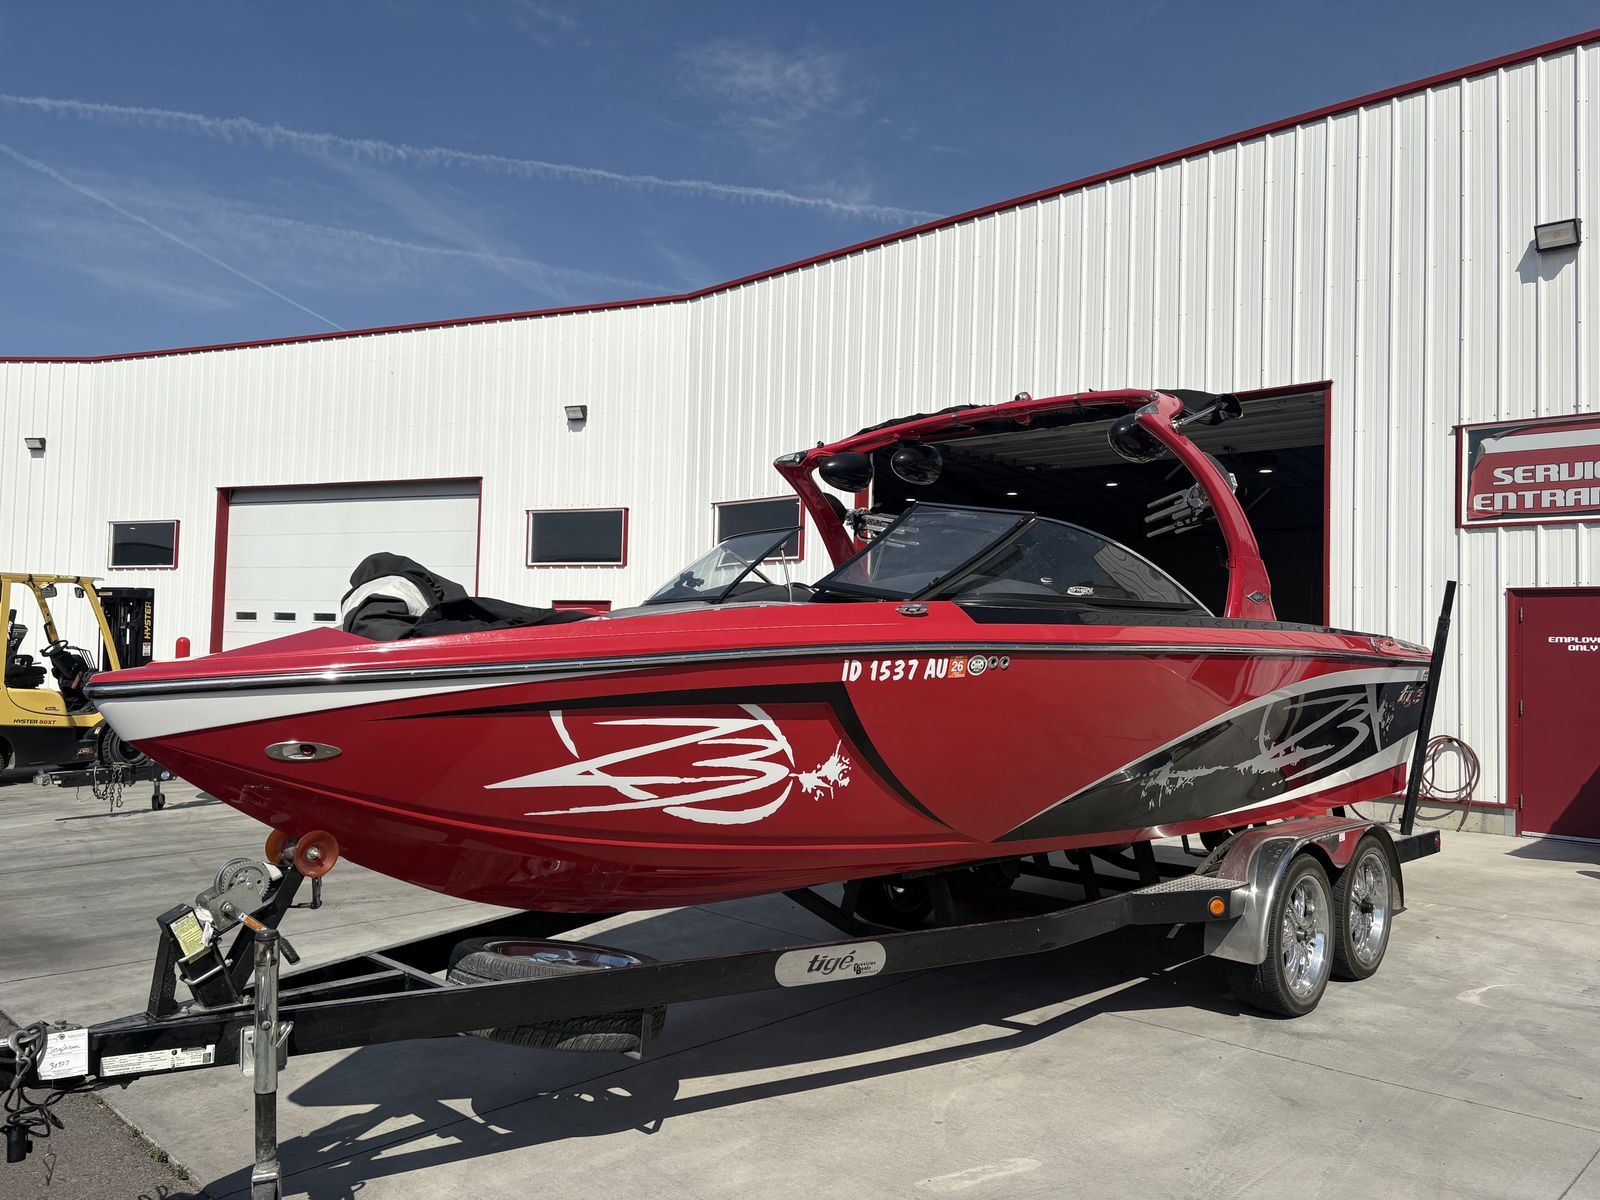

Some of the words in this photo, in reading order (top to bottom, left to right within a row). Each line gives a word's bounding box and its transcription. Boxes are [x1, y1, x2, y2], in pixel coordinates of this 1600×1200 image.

[143, 601, 151, 640] HYSTER
[1567, 644, 1599, 652] ONLY
[841, 660, 862, 682] ID
[870, 659, 919, 681] 1537
[923, 657, 949, 680] AU
[951, 660, 964, 672] 26
[806, 949, 856, 976] tigé
